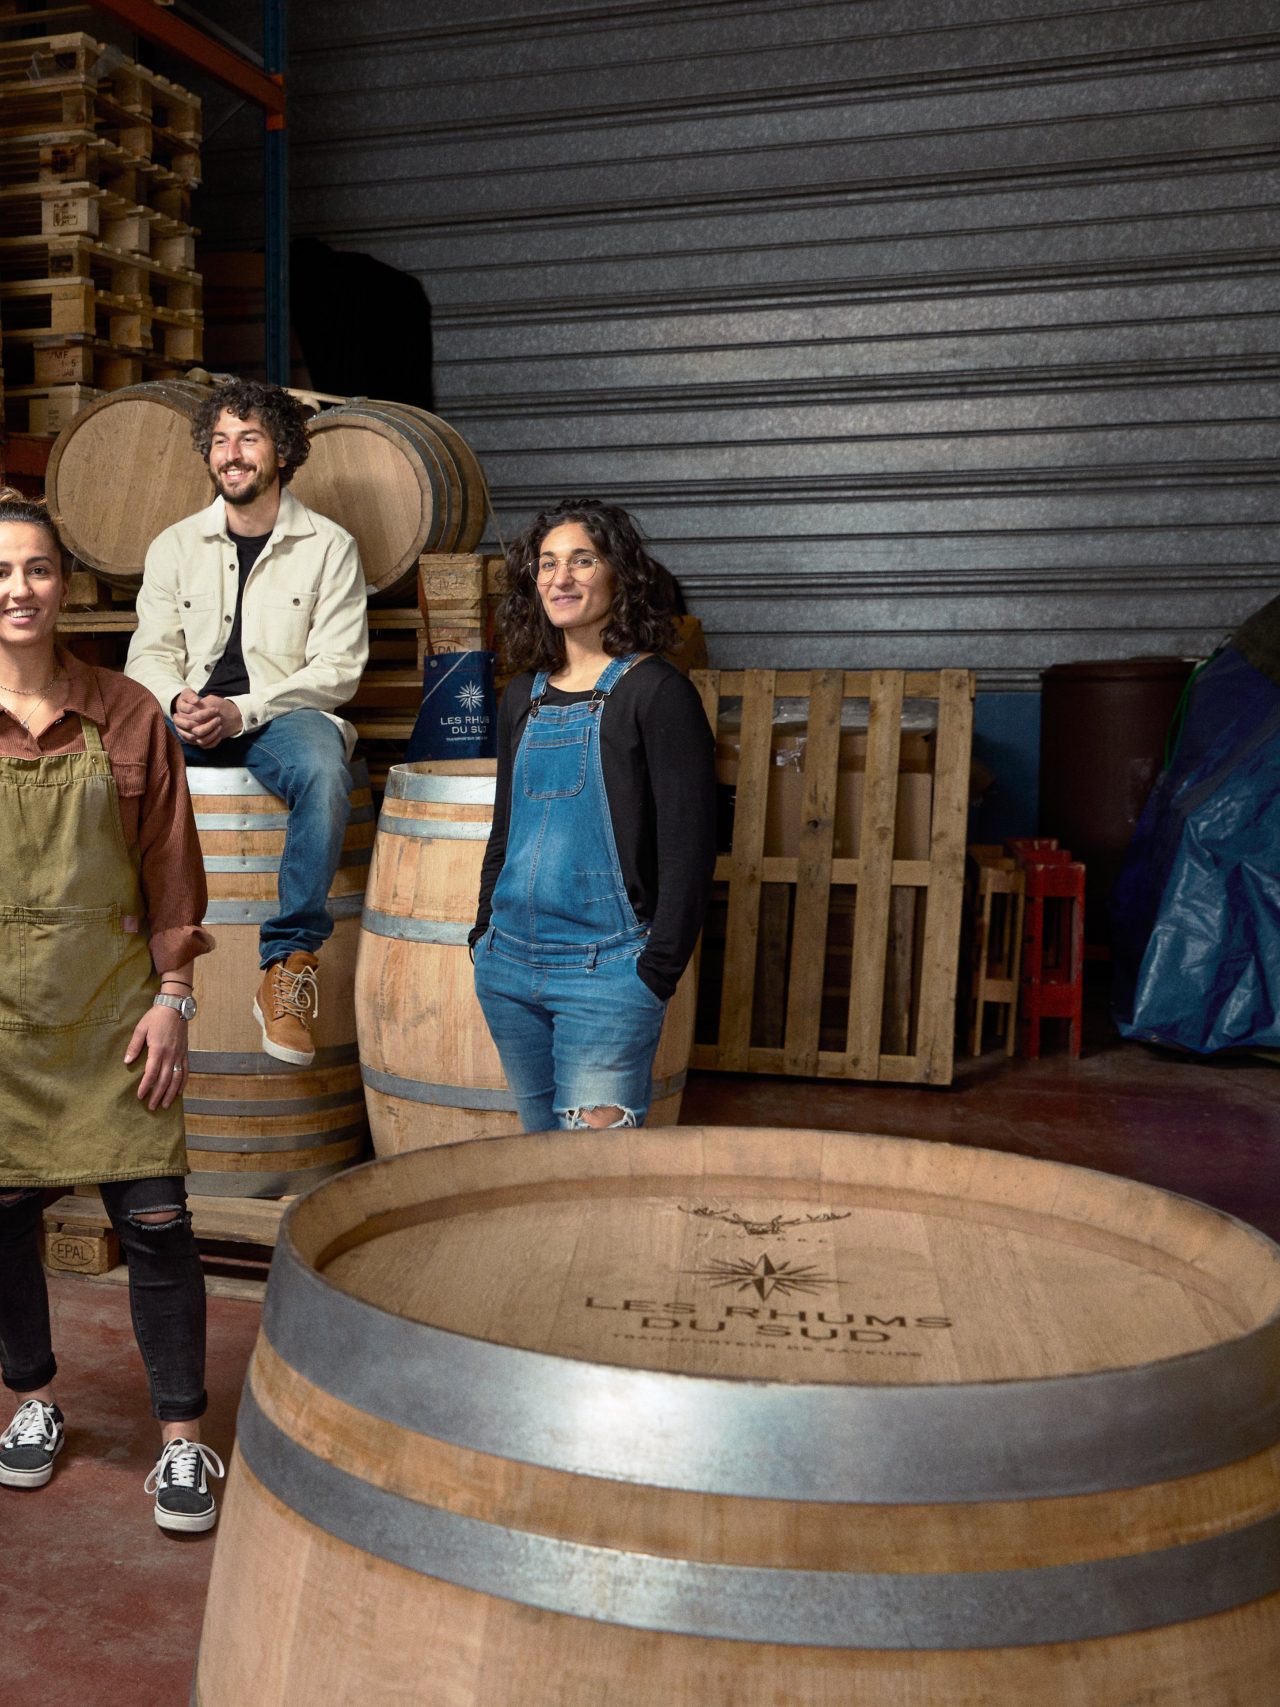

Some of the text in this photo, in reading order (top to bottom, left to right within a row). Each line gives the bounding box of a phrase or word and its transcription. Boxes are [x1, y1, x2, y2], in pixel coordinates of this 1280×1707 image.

[440, 716, 461, 725] LES
[452, 726, 468, 734] DU
[57, 1243, 88, 1261] EPAL
[585, 1297, 952, 1329] LES RHUMS
[641, 1317, 891, 1343] DU SUD
